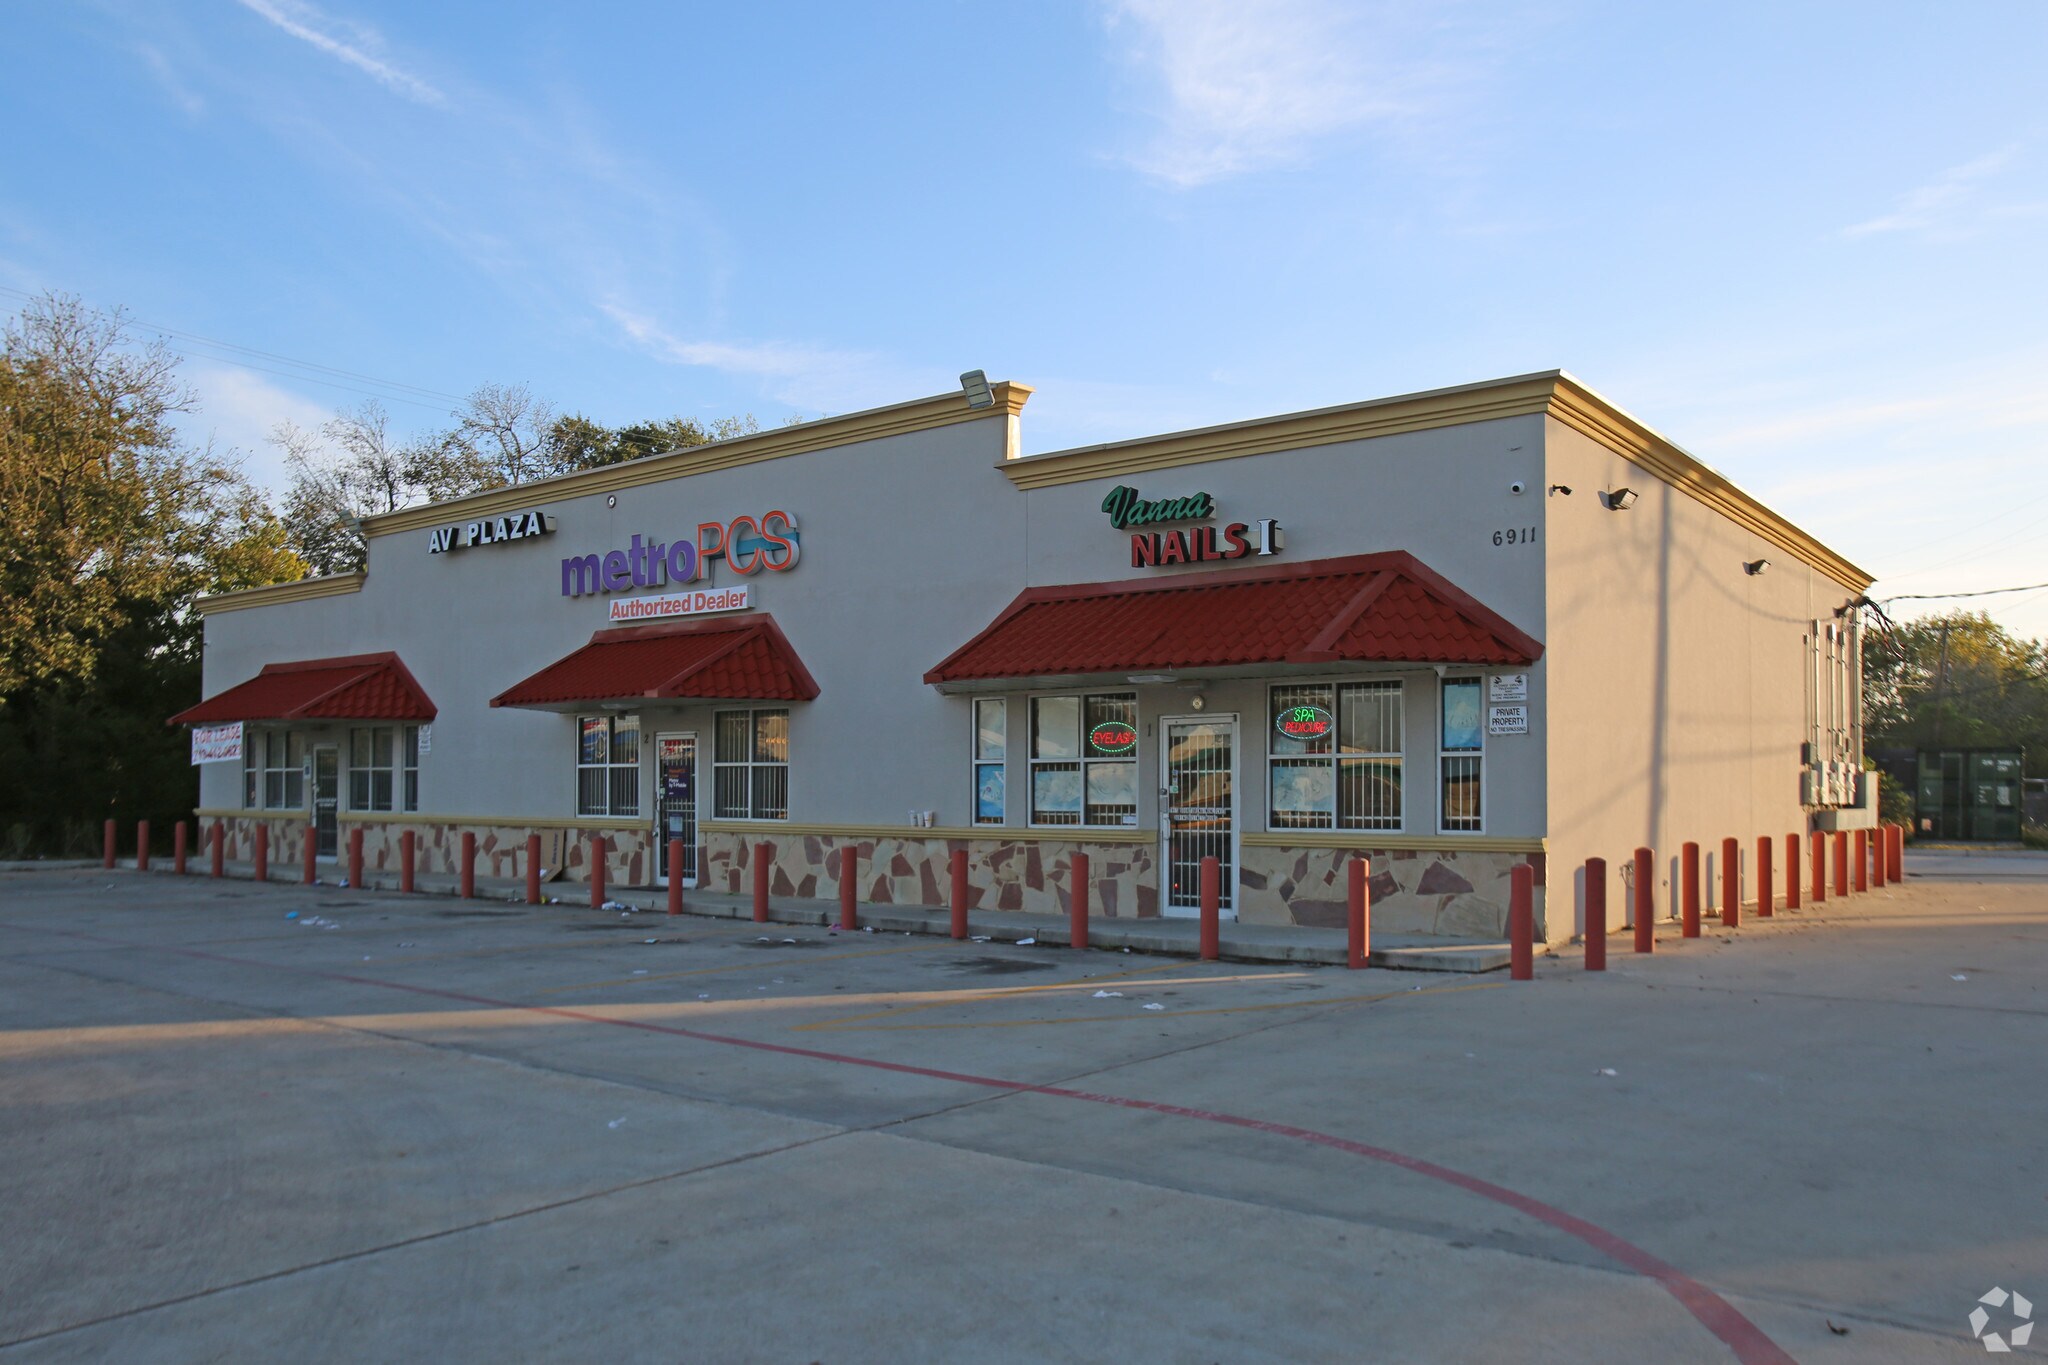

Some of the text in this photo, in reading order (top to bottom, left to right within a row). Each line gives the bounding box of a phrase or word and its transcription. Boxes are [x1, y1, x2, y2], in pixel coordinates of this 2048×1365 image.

[1102, 485, 1214, 529] Vanna
[428, 512, 545, 553] AV PLAZA
[1492, 526, 1536, 546] 6911
[561, 510, 799, 597] metroPCS
[1131, 523, 1249, 567] NAILS
[610, 590, 746, 619] Authorized Dealer
[1293, 708, 1315, 722] SPA
[1491, 717, 1524, 726] PROPERTY
[1496, 708, 1520, 716] PRIVATE
[194, 725, 240, 744] FOR LEASE
[1285, 721, 1327, 733] PEDICURE
